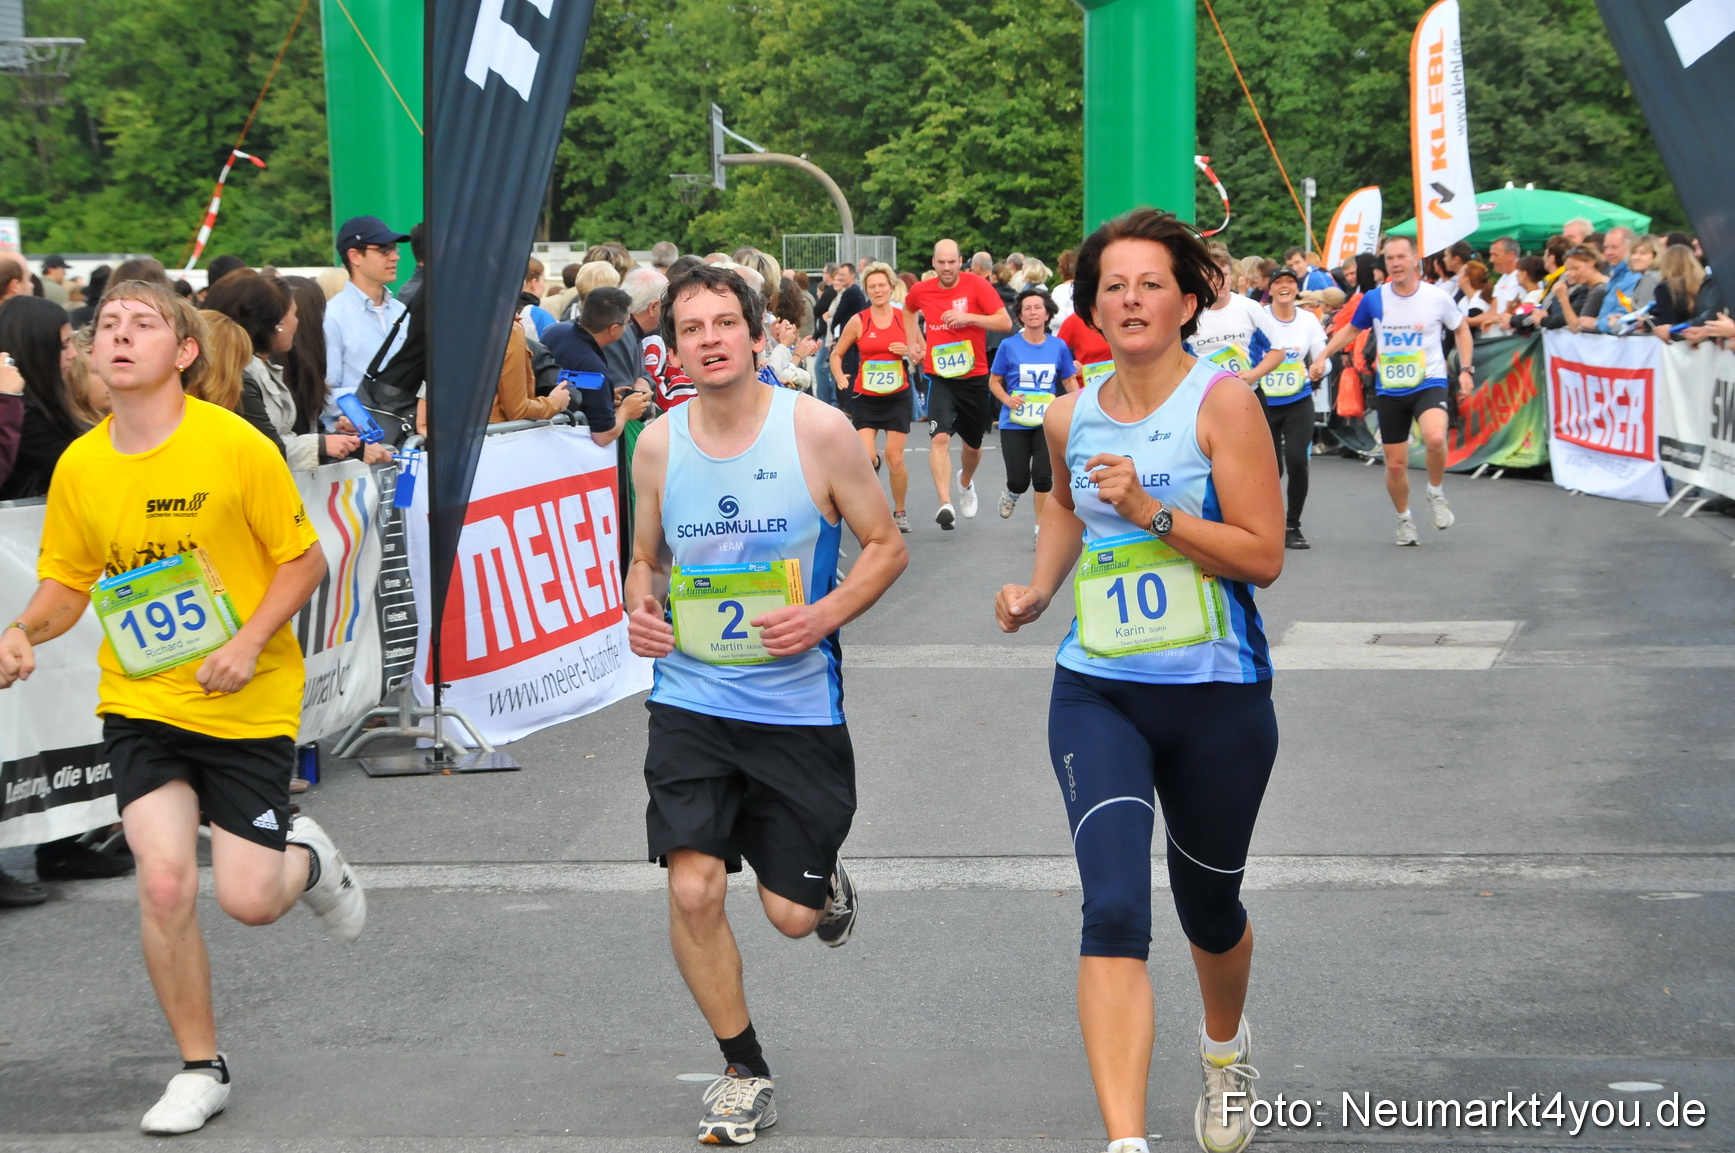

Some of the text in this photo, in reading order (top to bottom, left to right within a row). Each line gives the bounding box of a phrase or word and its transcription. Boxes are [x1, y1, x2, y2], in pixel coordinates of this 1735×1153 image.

[1428, 28, 1447, 171] KLEBL
[1196, 332, 1245, 347] DELPHI
[1383, 332, 1423, 346] TeVi
[937, 352, 966, 370] 944
[867, 371, 895, 385] 725
[1386, 364, 1415, 379] 680
[1265, 372, 1296, 387] 676
[1015, 403, 1045, 417] 914
[1557, 367, 1646, 454] MEIER
[146, 498, 187, 513] swn
[677, 518, 788, 538] SCHABMÜLLER
[717, 541, 744, 551] TEAM
[1091, 558, 1130, 574] firmenlauf
[457, 486, 623, 662] MEIER
[686, 585, 728, 595] firmenlauf
[1106, 572, 1167, 624] 10
[120, 589, 206, 649] 195
[717, 600, 748, 639] 2
[1115, 625, 1167, 638] Karin Stahn
[145, 640, 183, 659] Richard
[710, 642, 743, 652] Martin
[53, 765, 82, 790] die
[252, 819, 279, 831] adidas
